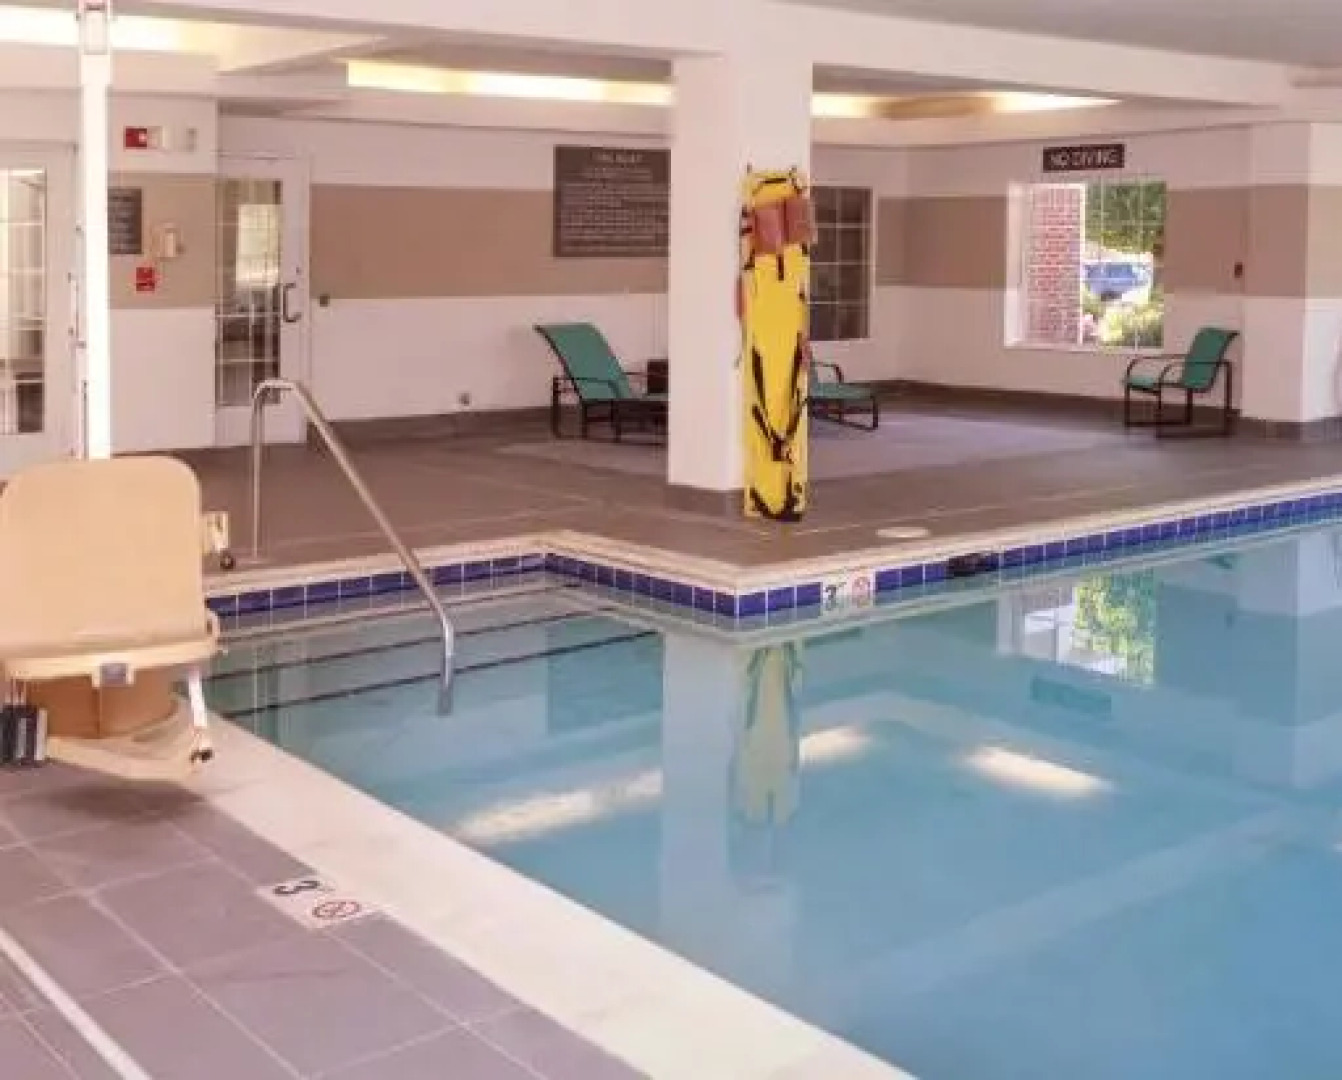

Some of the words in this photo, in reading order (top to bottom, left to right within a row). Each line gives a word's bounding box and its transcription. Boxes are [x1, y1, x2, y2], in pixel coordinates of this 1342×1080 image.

[1050, 151, 1069, 167] NO
[1071, 148, 1118, 166] DIVING
[273, 880, 320, 896] 3
